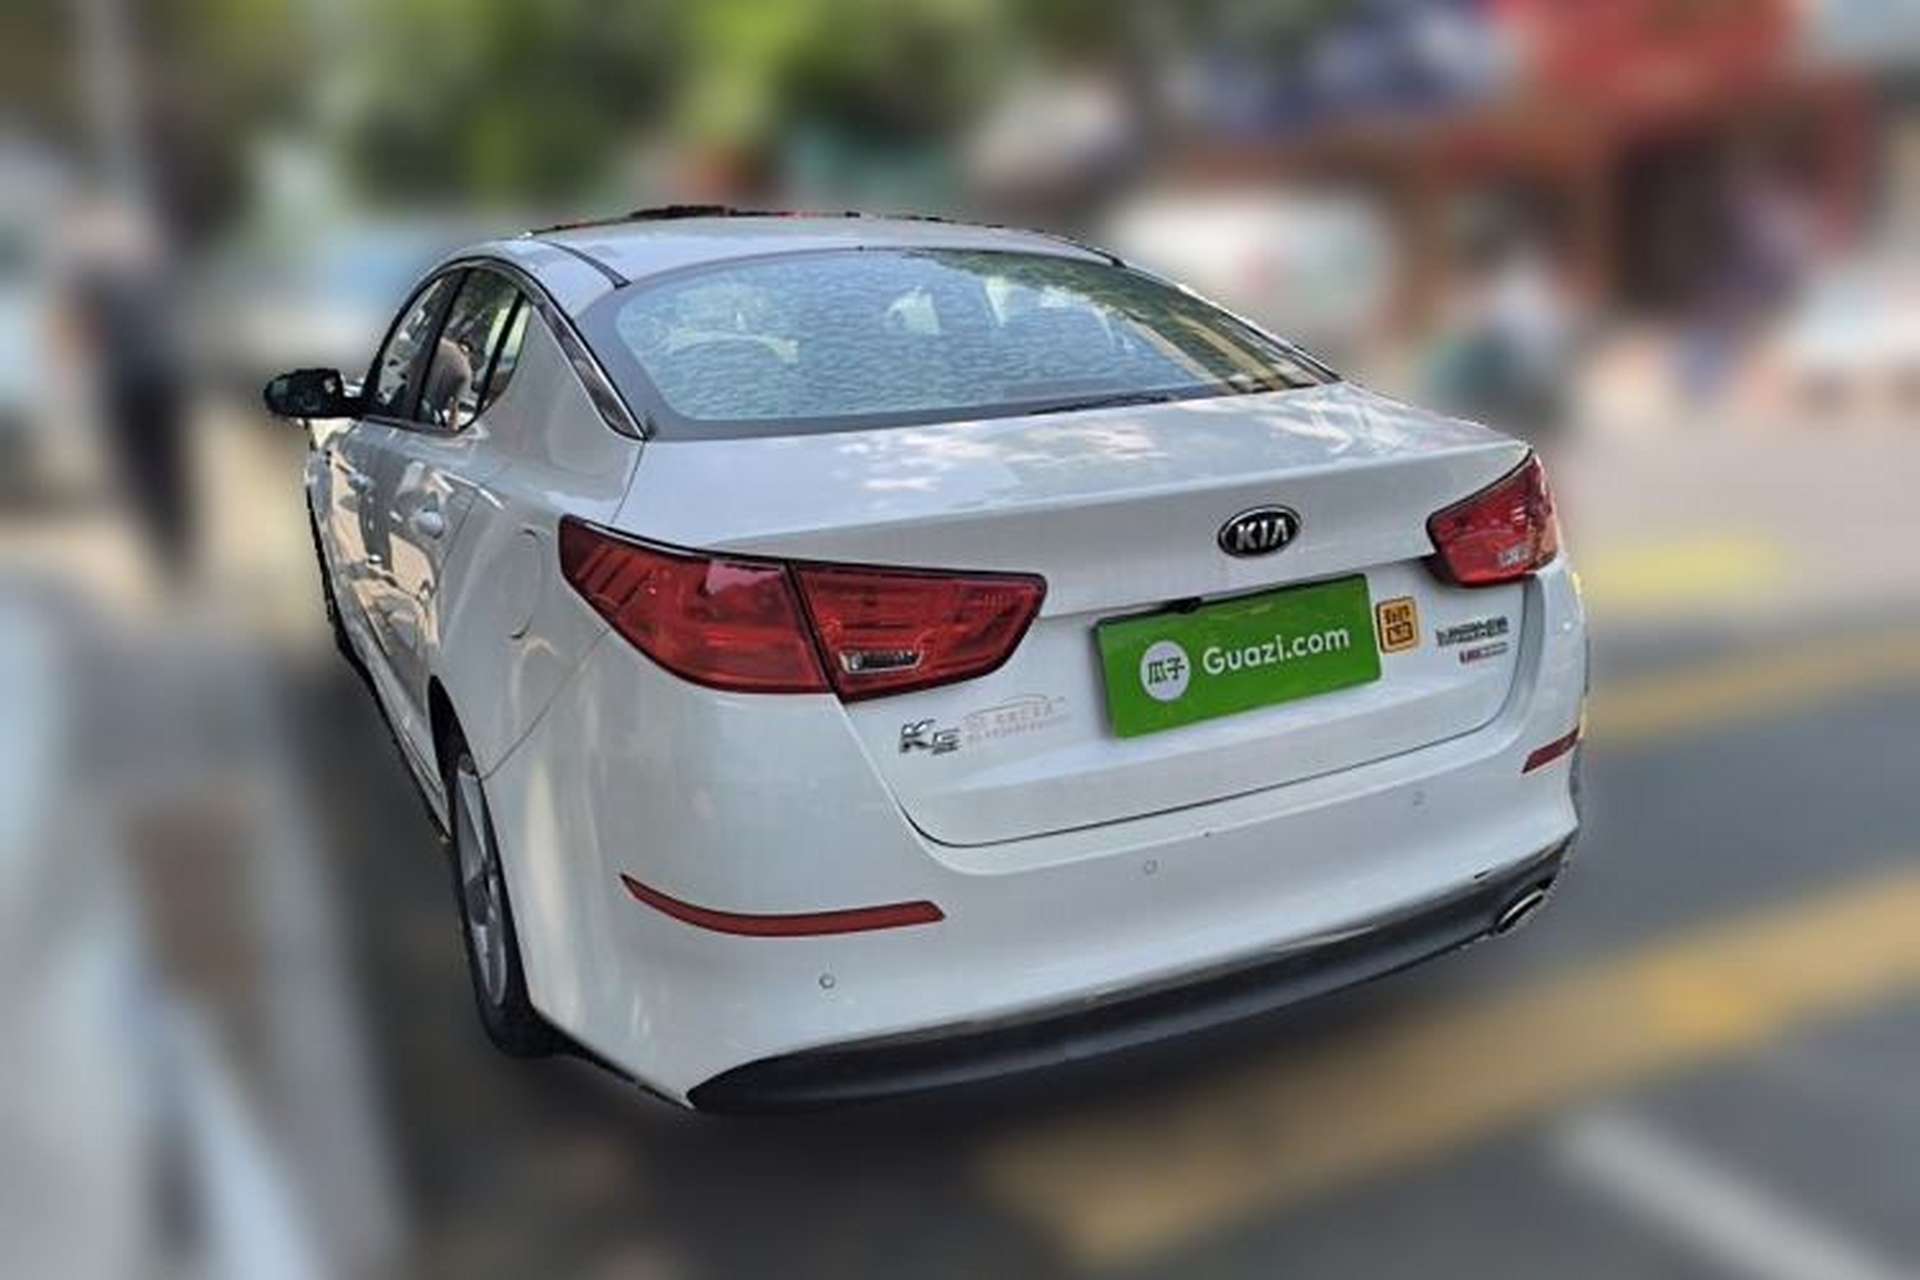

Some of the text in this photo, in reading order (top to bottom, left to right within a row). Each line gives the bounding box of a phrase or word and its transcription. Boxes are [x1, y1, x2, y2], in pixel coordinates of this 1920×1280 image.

[1235, 519, 1289, 551] KIA
[1203, 628, 1350, 675] Guazi.com
[1148, 656, 1186, 685] 瓜子
